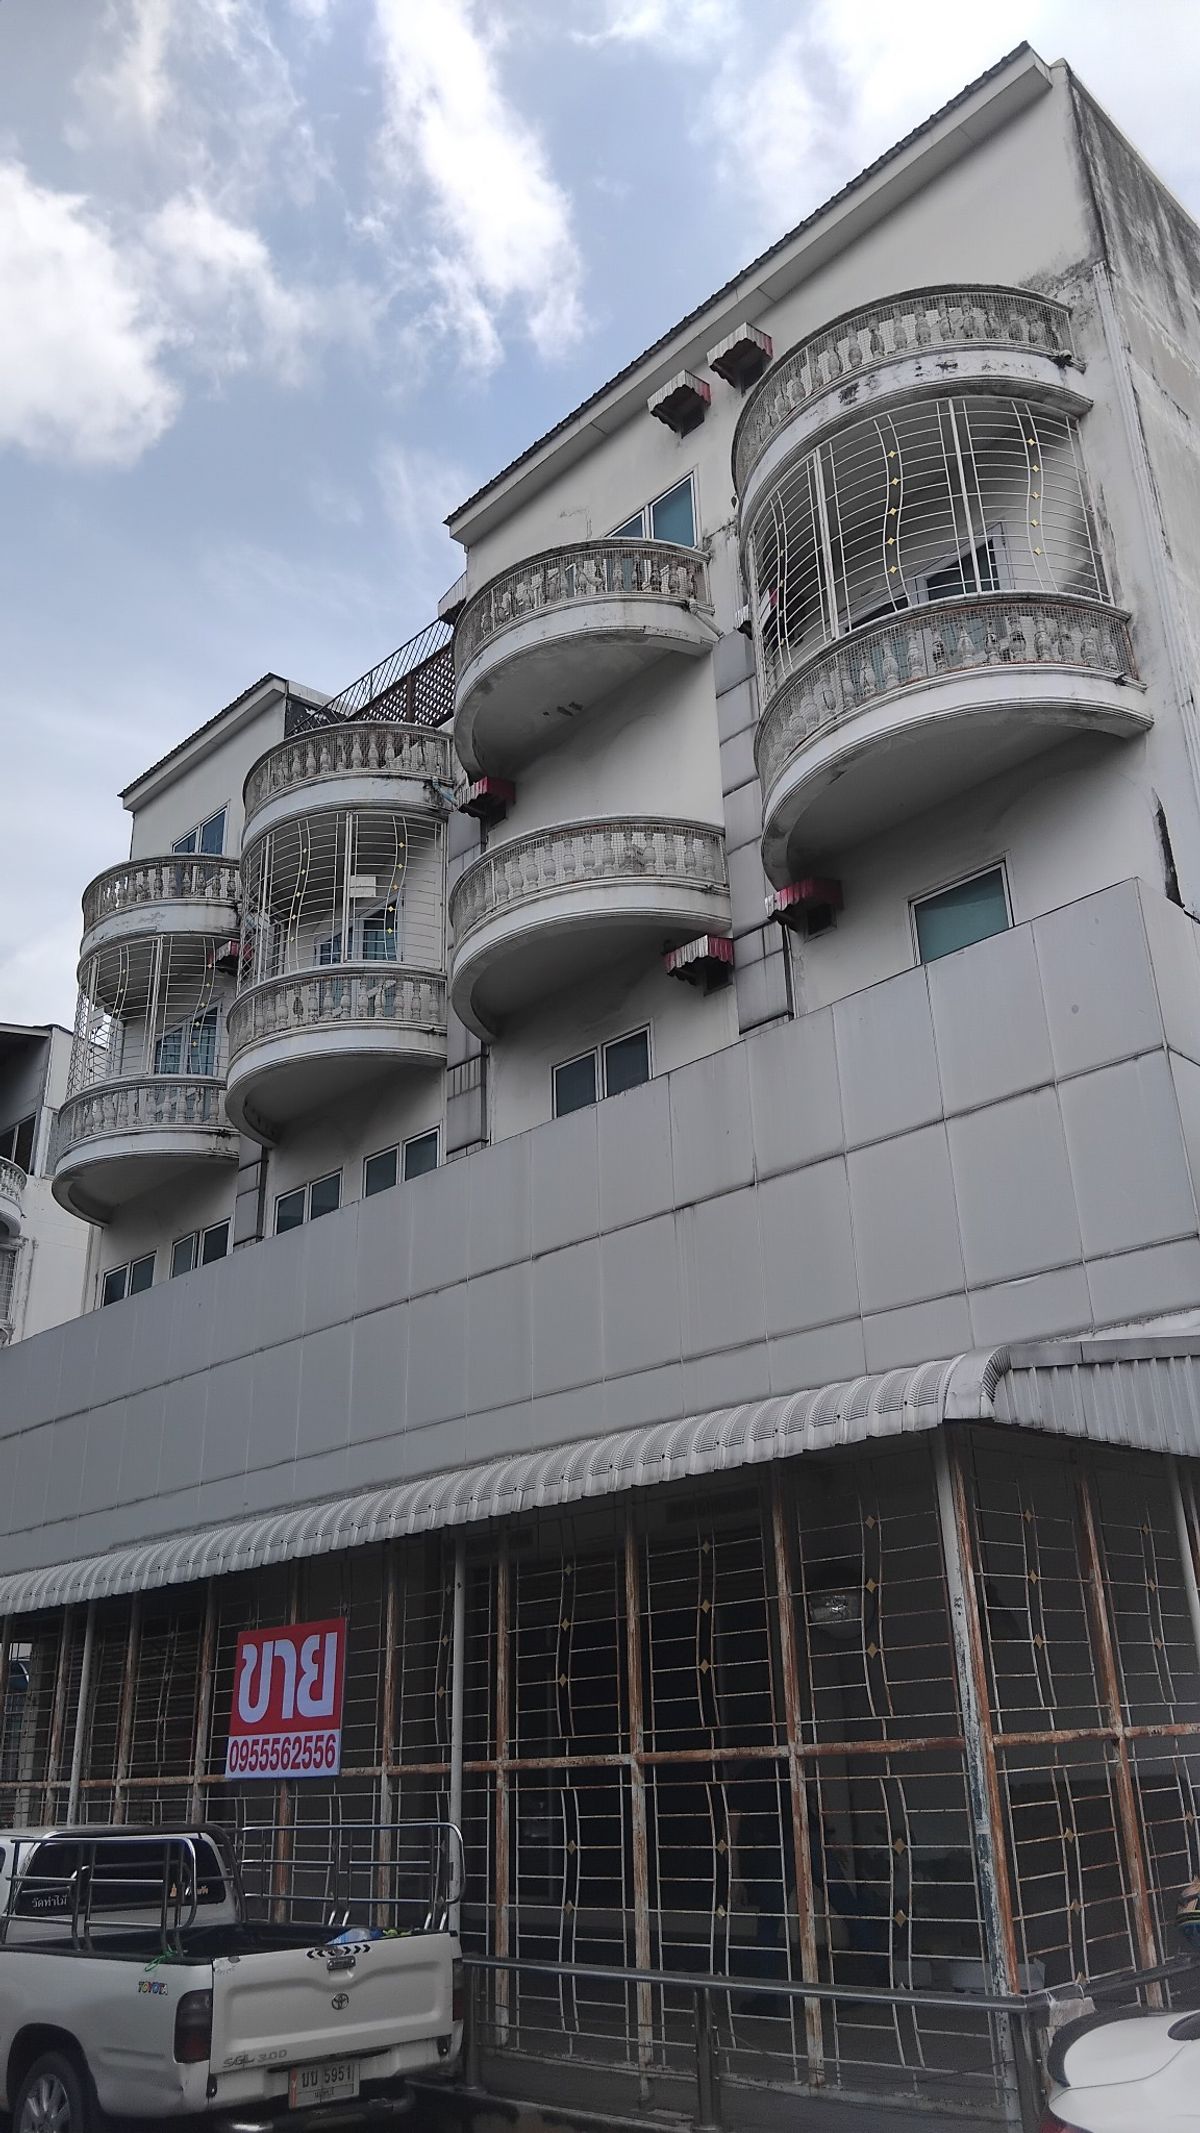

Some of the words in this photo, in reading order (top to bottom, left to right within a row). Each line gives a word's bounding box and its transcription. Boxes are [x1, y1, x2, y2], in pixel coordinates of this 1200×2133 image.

[238, 1632, 338, 1724] ขาย
[229, 1733, 336, 1773] 0955562556
[324, 2064, 351, 2084] 5951
